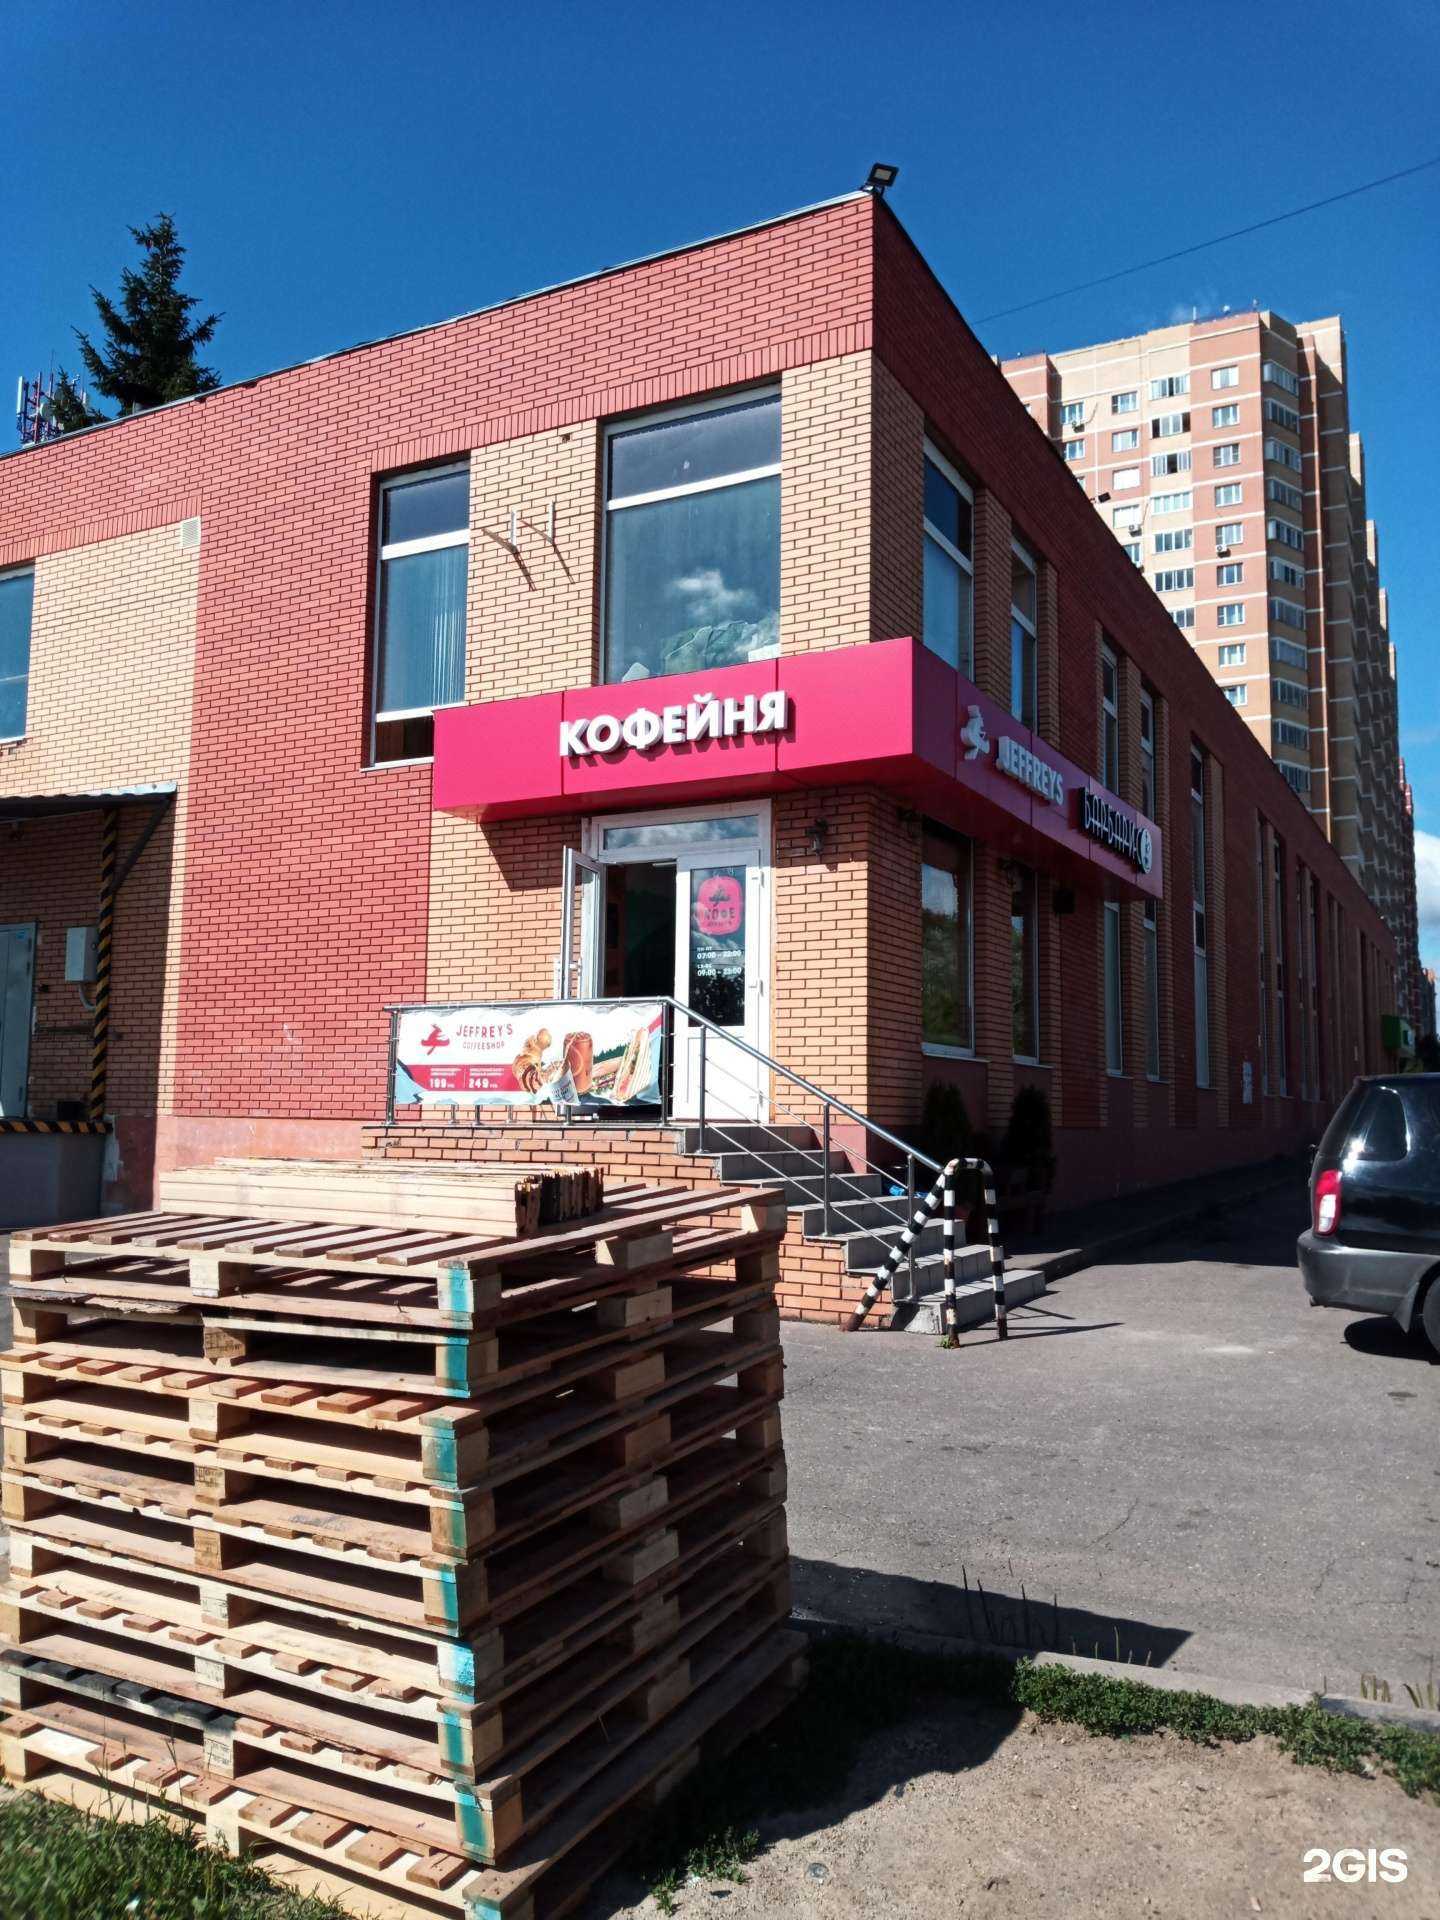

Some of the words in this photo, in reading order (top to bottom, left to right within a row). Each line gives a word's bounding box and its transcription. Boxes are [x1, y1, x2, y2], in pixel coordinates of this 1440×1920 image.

[559, 690, 788, 757] КОФЕЙНЯ
[455, 1023, 513, 1038] JEFFREY'S
[463, 1040, 505, 1050] COFFEESHOP
